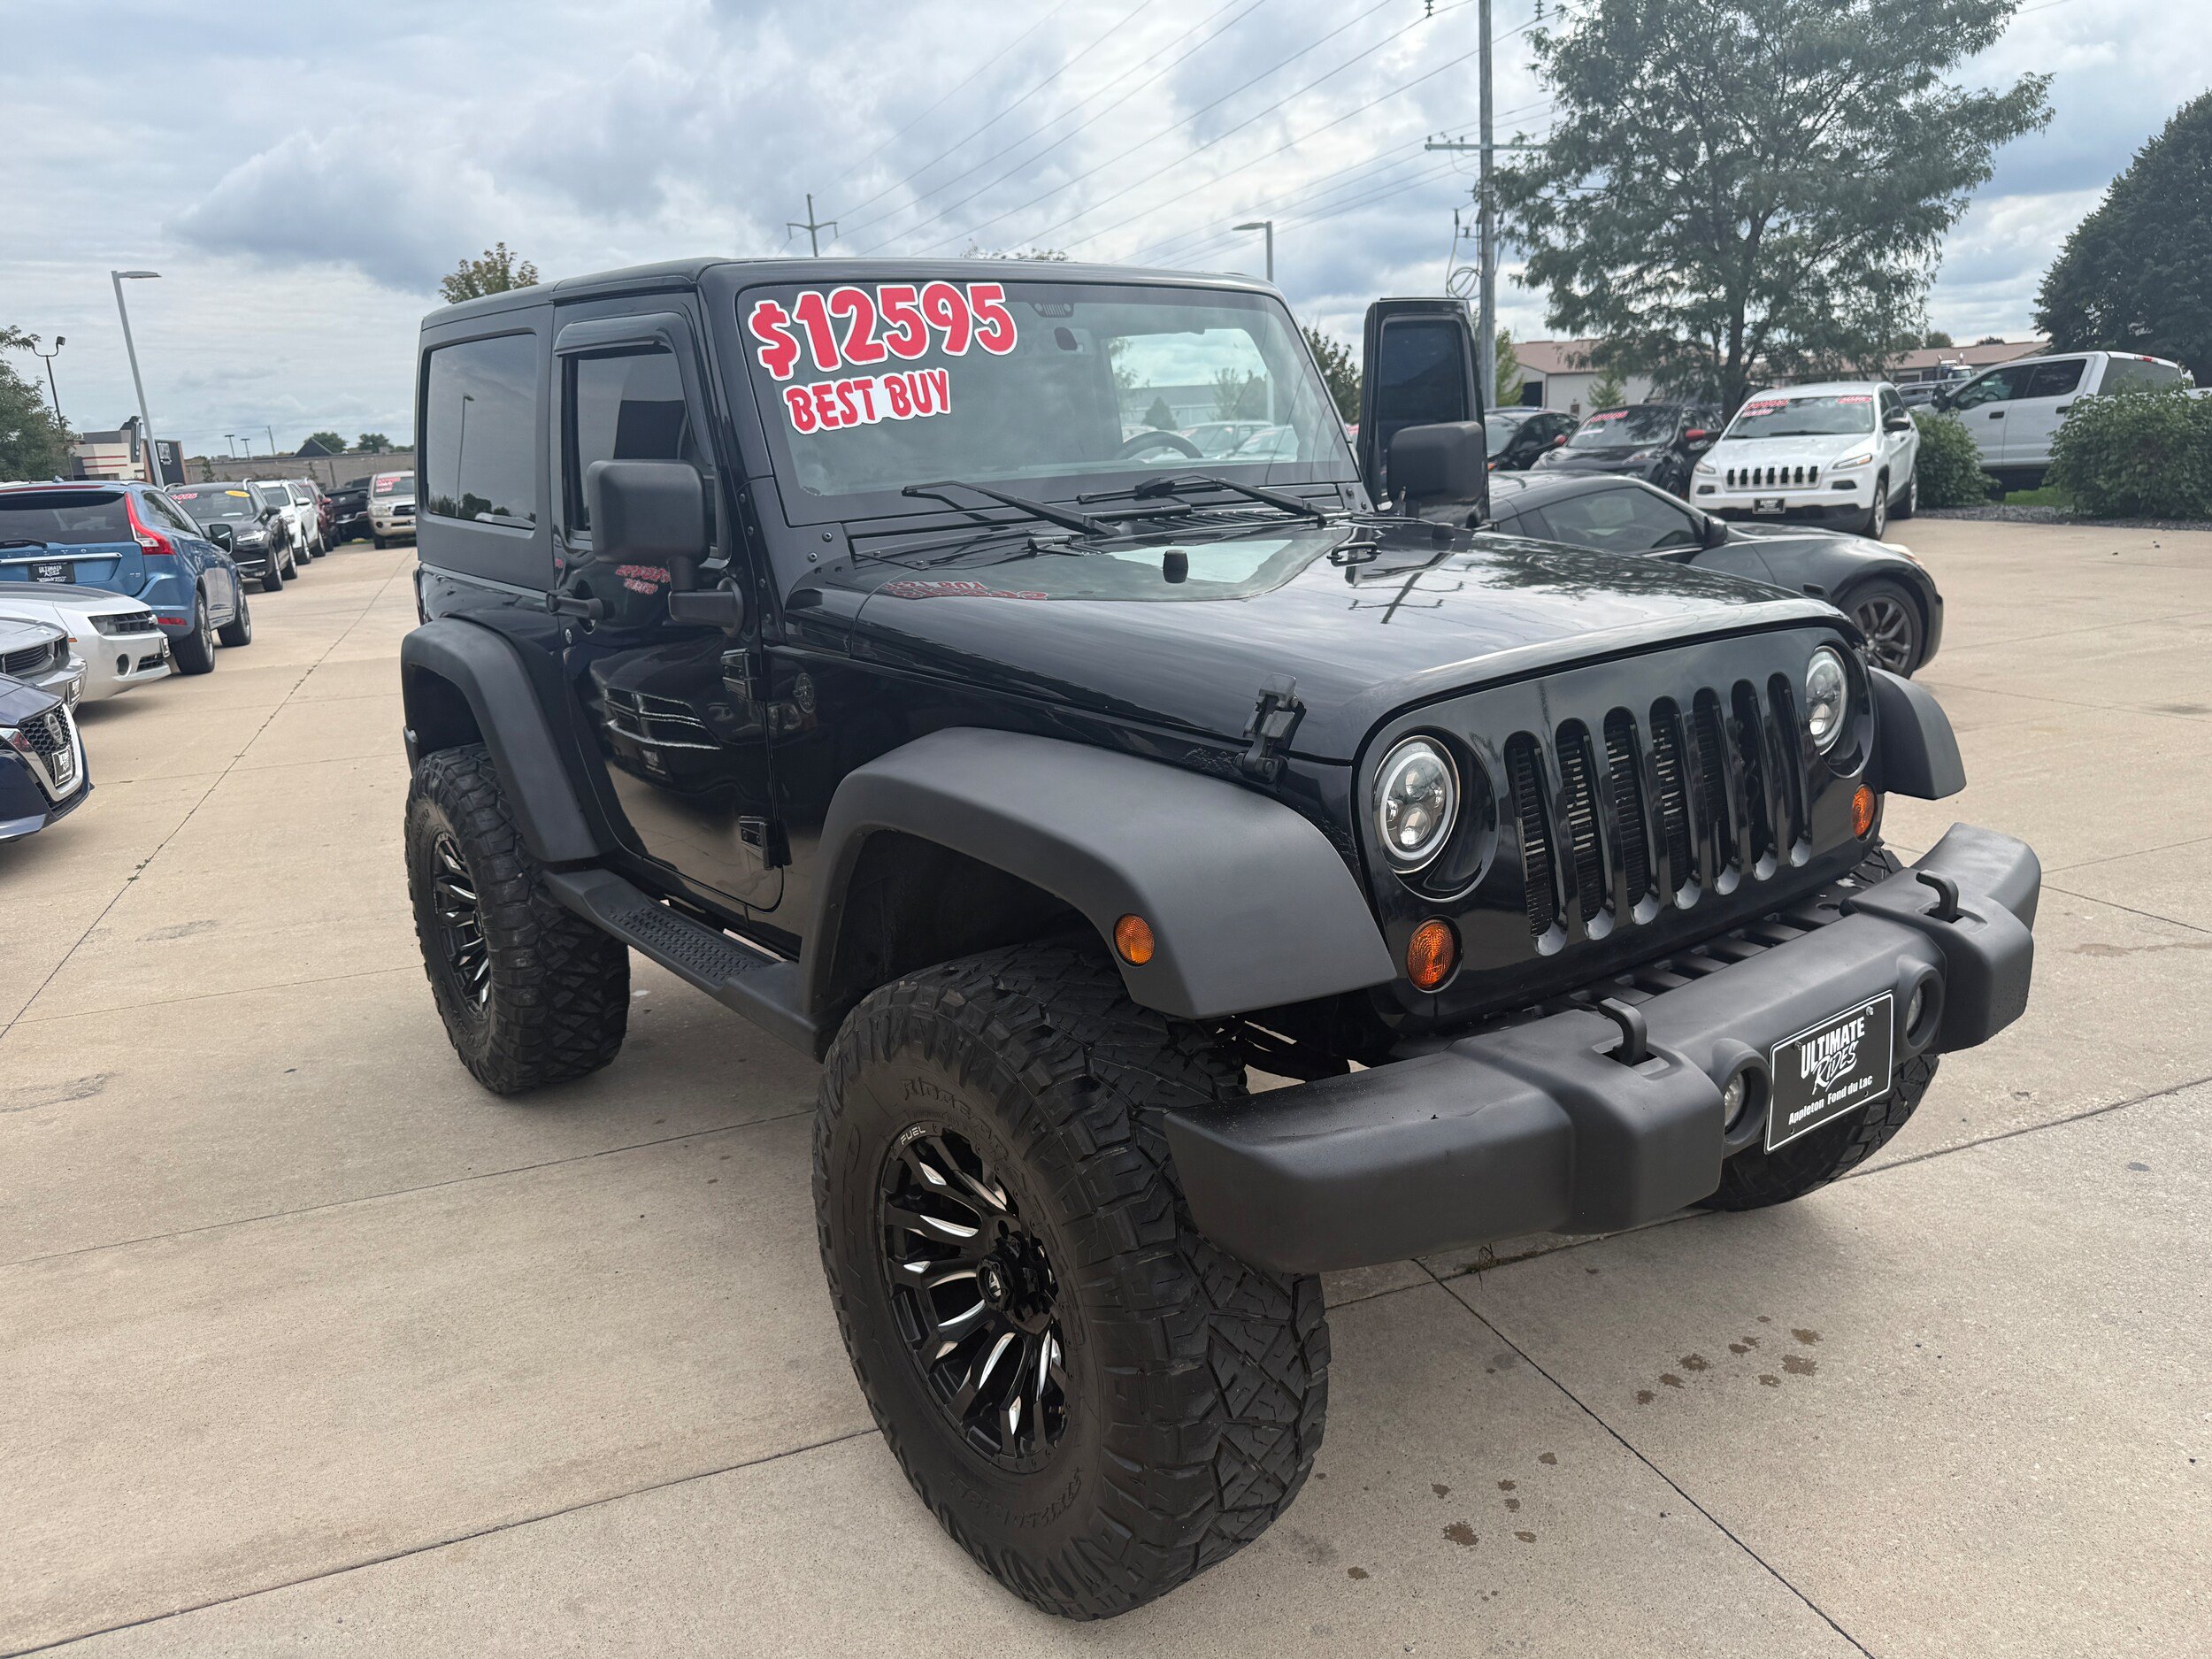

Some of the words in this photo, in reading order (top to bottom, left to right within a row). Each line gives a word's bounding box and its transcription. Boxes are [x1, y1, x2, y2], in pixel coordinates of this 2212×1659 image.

[749, 281, 1018, 380] $12595
[784, 380, 879, 434] BEST
[881, 368, 950, 420] BUY
[1800, 1016, 1865, 1079] ULTIMATE
[1812, 1041, 1859, 1094] RIDES
[1788, 1099, 1824, 1125] Appleton
[1827, 1087, 1847, 1105] Fond
[1847, 1082, 1859, 1095] du
[1859, 1075, 1873, 1090] Lac
[900, 1125, 926, 1146] FUEL
